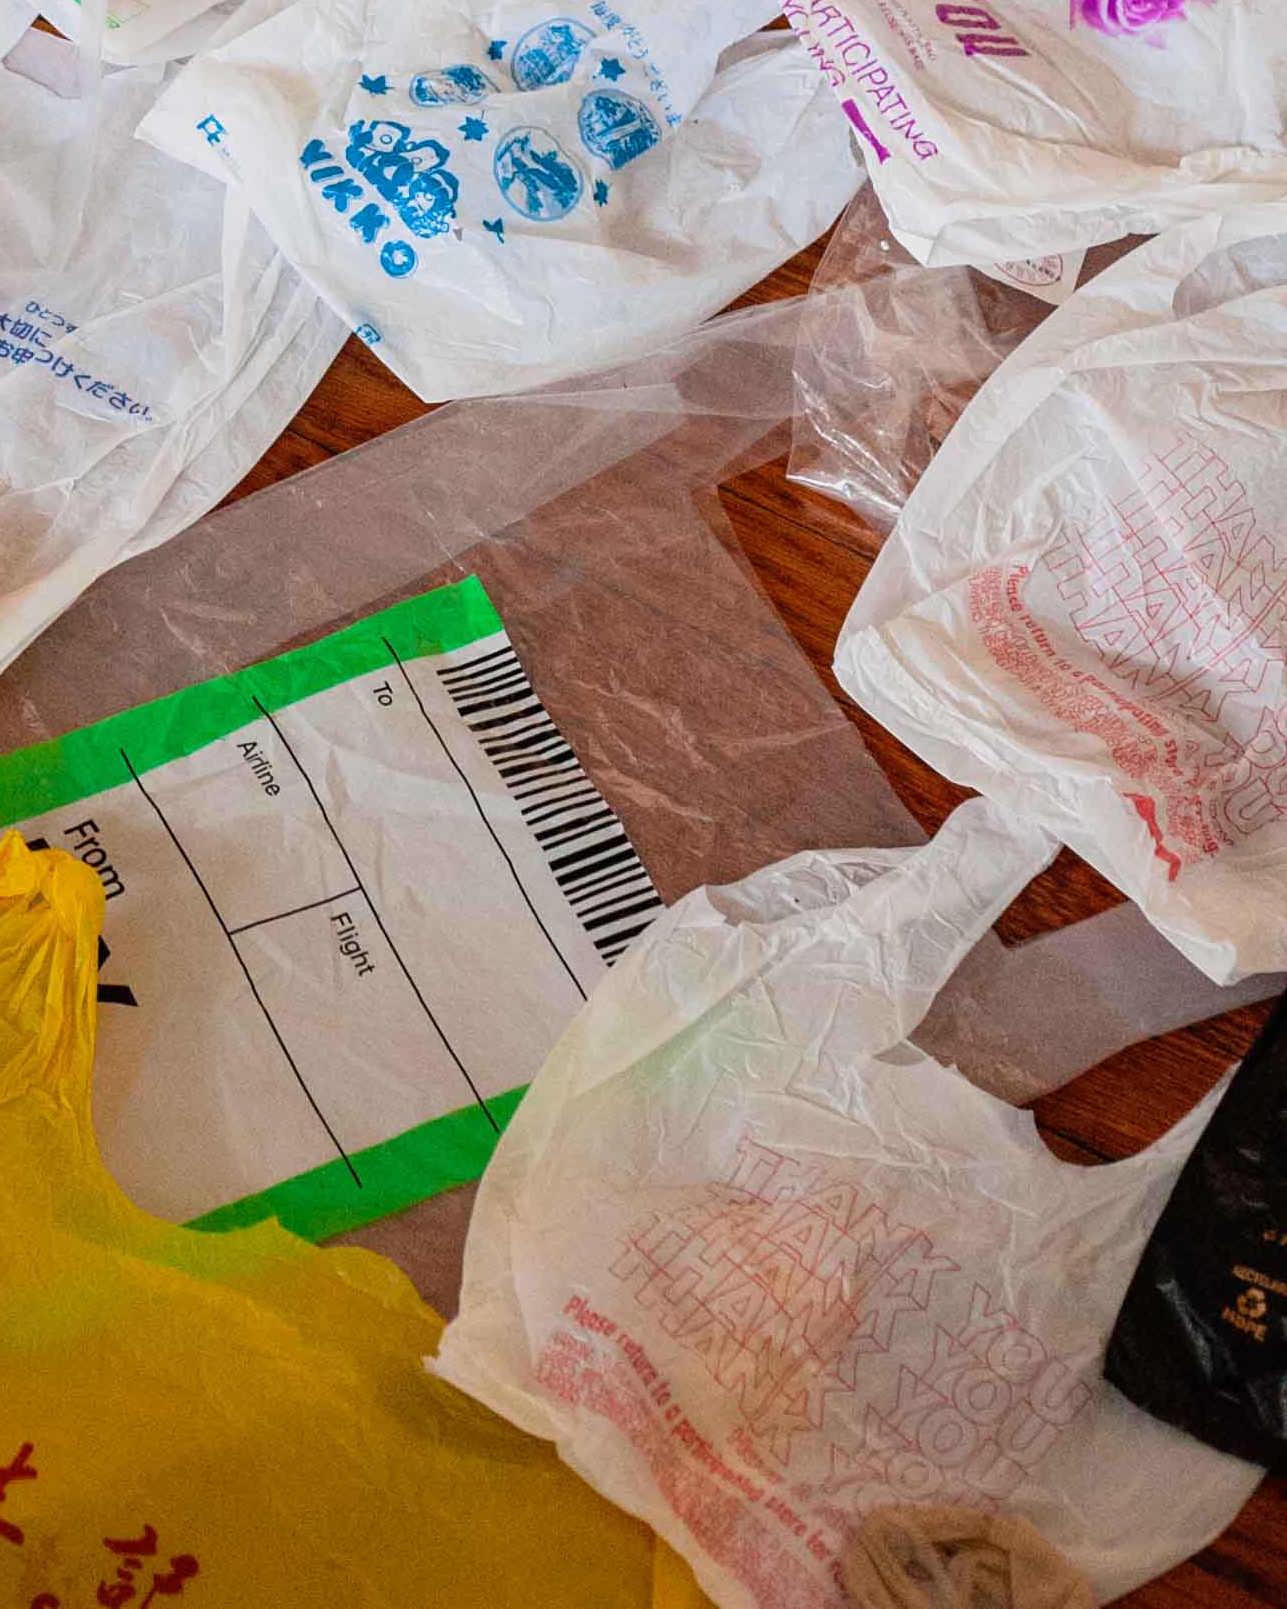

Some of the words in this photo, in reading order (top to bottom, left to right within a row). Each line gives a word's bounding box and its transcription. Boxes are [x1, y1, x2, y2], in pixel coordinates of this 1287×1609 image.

[372, 680, 395, 709] To
[236, 738, 282, 798] Airline
[64, 819, 125, 901] From
[329, 911, 376, 979] Flight
[565, 1295, 618, 1337] Please
[617, 1333, 658, 1387] return
[650, 1381, 671, 1407] to
